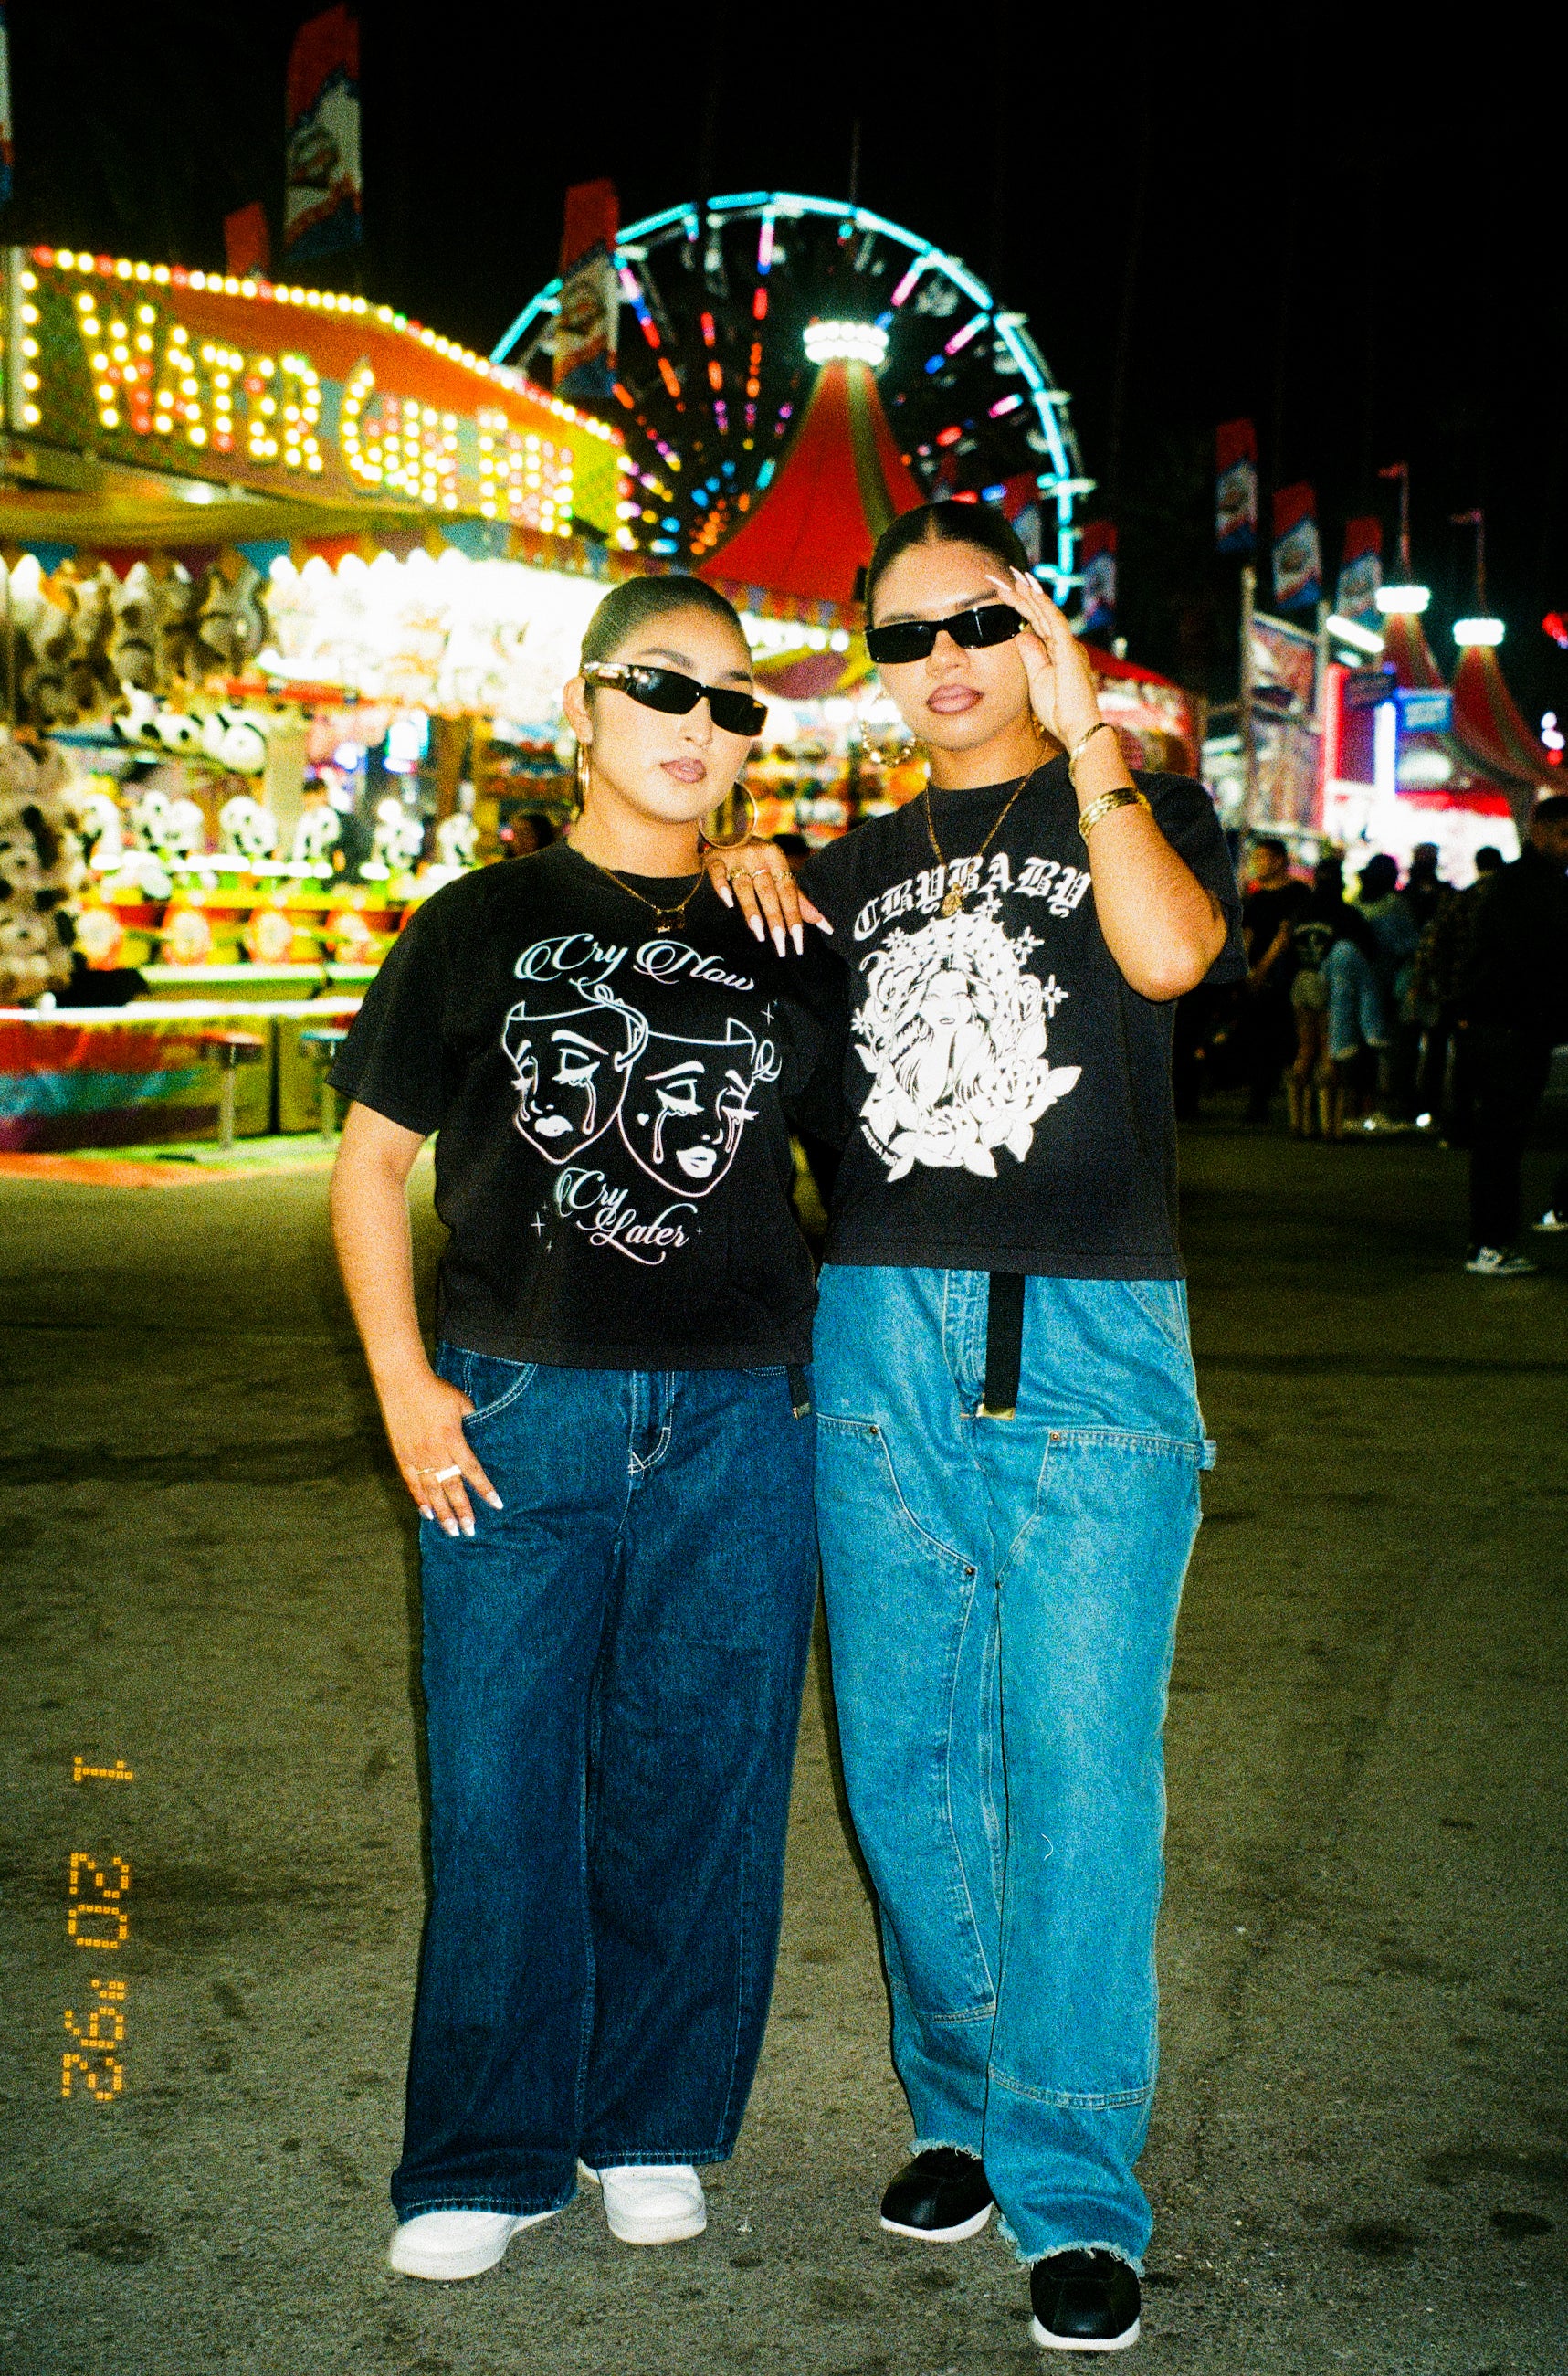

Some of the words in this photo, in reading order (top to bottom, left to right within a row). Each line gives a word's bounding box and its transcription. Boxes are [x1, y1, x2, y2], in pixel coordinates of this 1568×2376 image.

[77, 290, 323, 473] WATER
[854, 851, 1092, 942] CRYBABY
[514, 933, 629, 986] Cry
[632, 939, 756, 991] Now
[554, 1167, 629, 1218] Cry
[575, 1203, 699, 1265] Later
